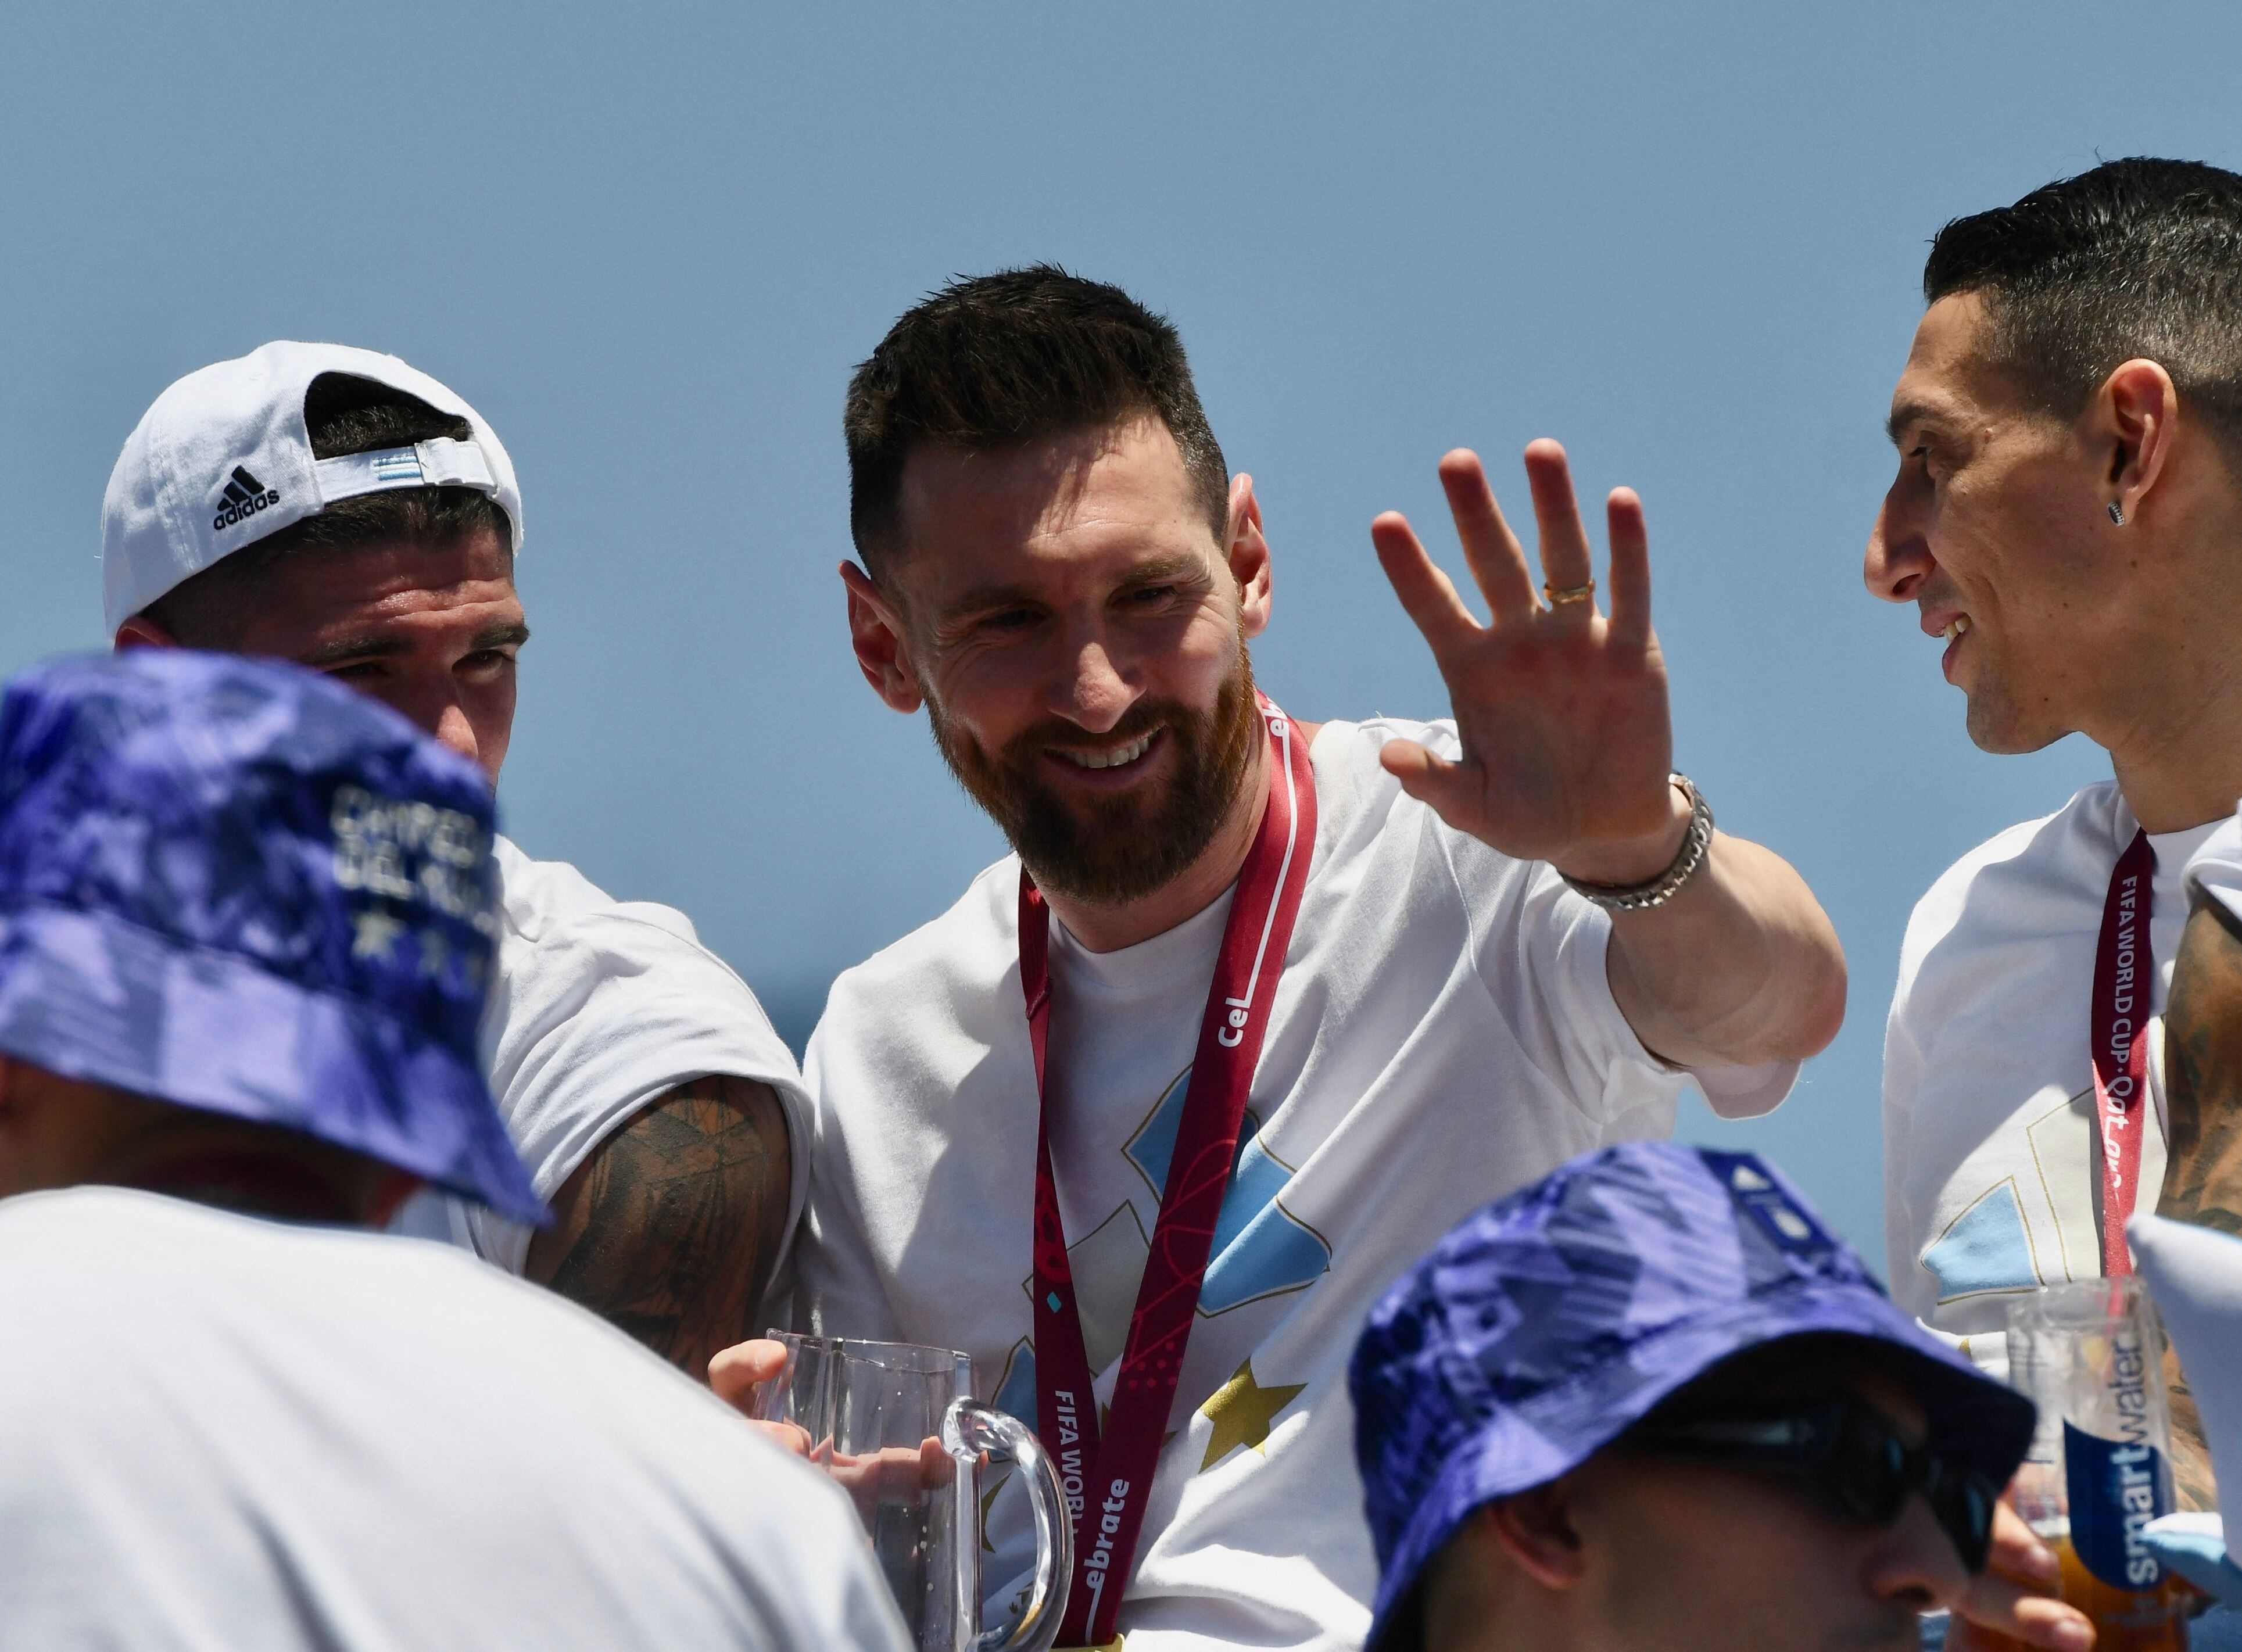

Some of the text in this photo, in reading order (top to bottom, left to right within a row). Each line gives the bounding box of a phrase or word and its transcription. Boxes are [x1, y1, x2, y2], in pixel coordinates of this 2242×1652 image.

[214, 486, 280, 530] adidas
[2118, 875, 2138, 927] FIFA
[2114, 930, 2135, 1013] WORLD
[2110, 1018, 2132, 1065] CUP
[1055, 1391, 1079, 1446] FIFA
[2106, 1335, 2159, 1586] smartwater
